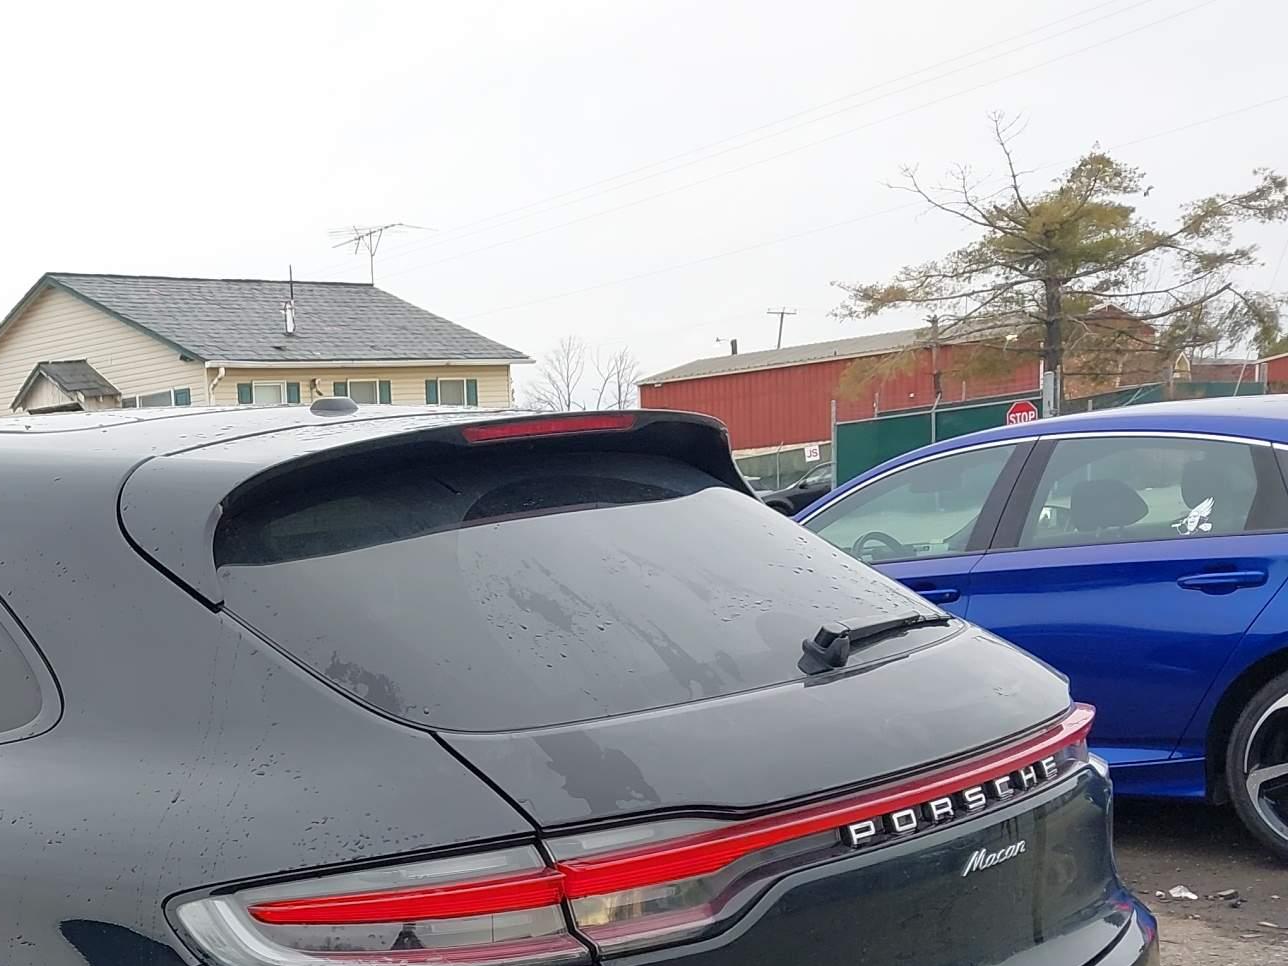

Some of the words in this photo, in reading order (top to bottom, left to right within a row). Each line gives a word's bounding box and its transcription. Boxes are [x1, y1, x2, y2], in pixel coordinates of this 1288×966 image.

[1009, 411, 1035, 424] STOP
[807, 448, 818, 458] JS
[849, 756, 1057, 847] PORSCHE
[961, 840, 1027, 877] Macan
